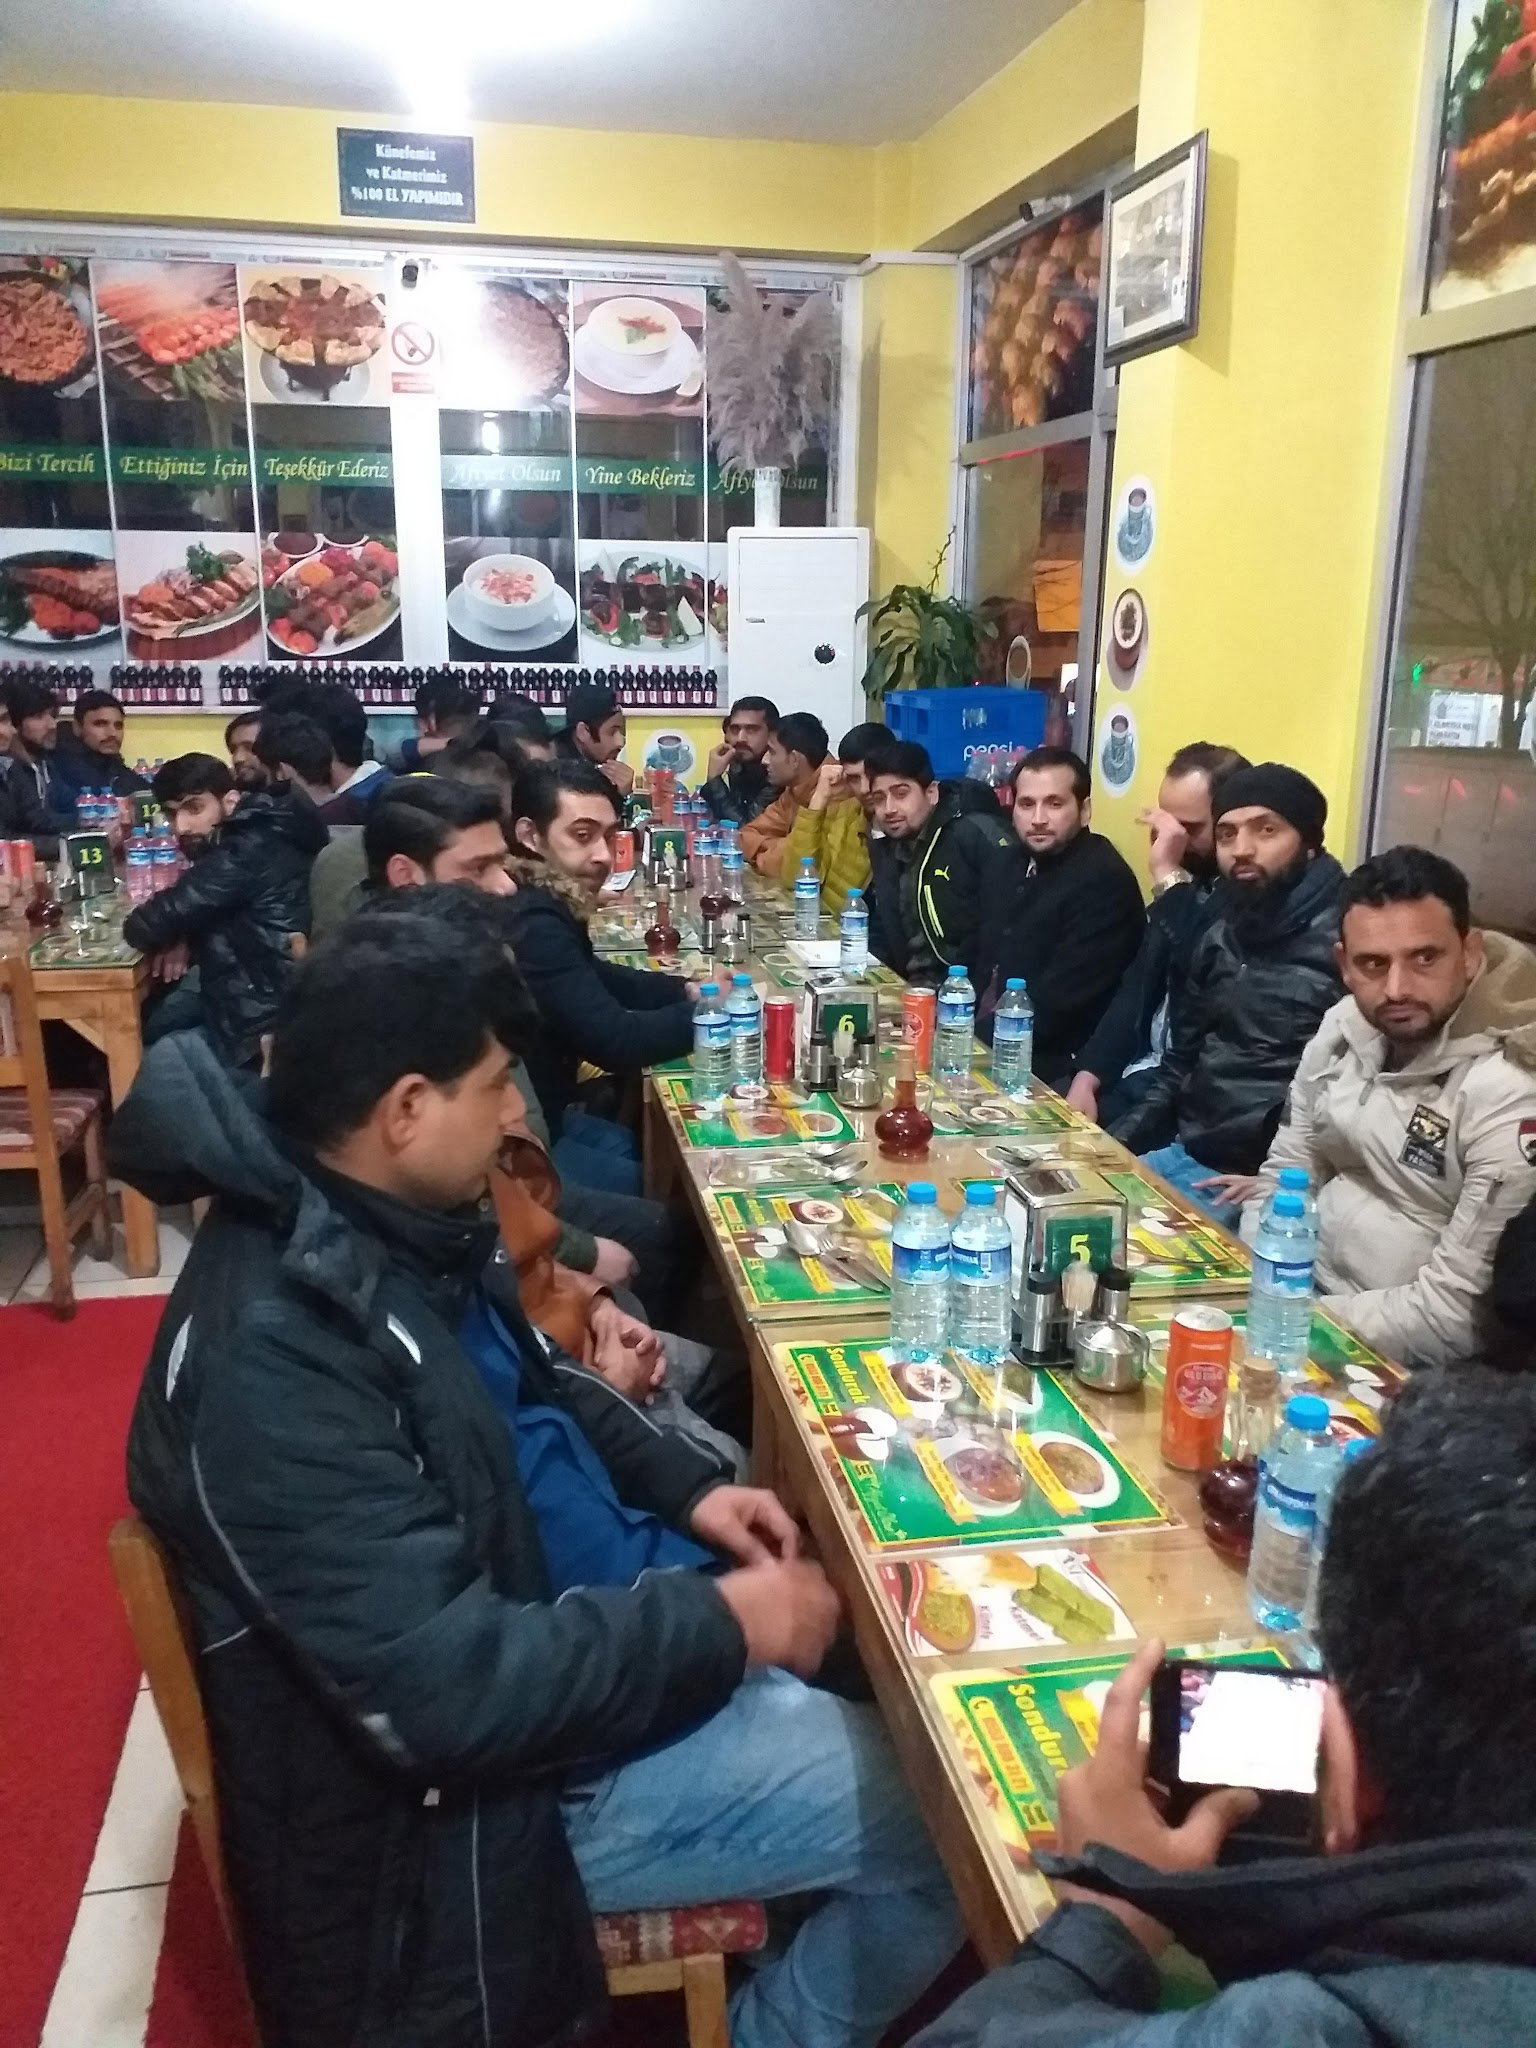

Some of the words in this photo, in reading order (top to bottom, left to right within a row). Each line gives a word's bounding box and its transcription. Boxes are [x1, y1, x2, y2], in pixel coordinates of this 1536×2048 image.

[375, 143, 436, 161] Künefemiz
[366, 167, 380, 180] ve
[382, 165, 448, 184] Katmerimiz
[351, 186, 383, 201] %100
[385, 188, 399, 202] EL
[36, 453, 95, 473] Tercih
[120, 456, 206, 480] Ettiğiniz
[264, 456, 335, 481] Teşekkür
[336, 458, 389, 479] Ederiz
[511, 464, 560, 482] Olsun
[585, 466, 623, 485] Yine
[627, 467, 696, 490] Bekleriz
[80, 847, 103, 864] 13
[839, 1014, 855, 1037] 6
[1070, 1234, 1091, 1266] 5
[1007, 1683, 1069, 1779] Sondur
